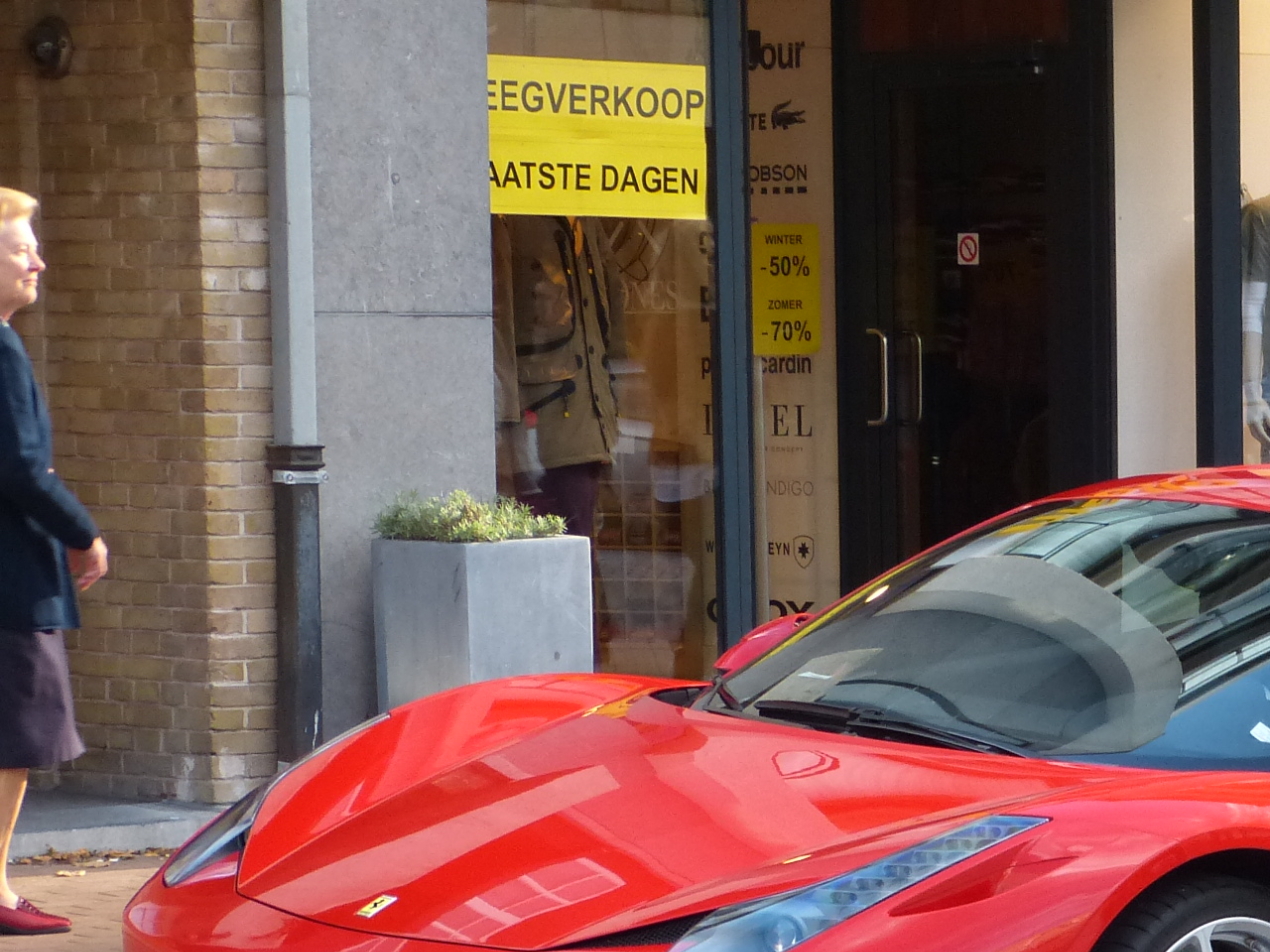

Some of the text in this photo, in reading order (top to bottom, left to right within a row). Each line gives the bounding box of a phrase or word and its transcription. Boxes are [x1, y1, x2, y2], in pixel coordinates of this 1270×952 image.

[601, 165, 699, 195] DAGEN
[764, 234, 803, 245] WINTER
[760, 255, 810, 278] -50%
[768, 299, 803, 311] ZOMER
[761, 321, 812, 342] -70%
